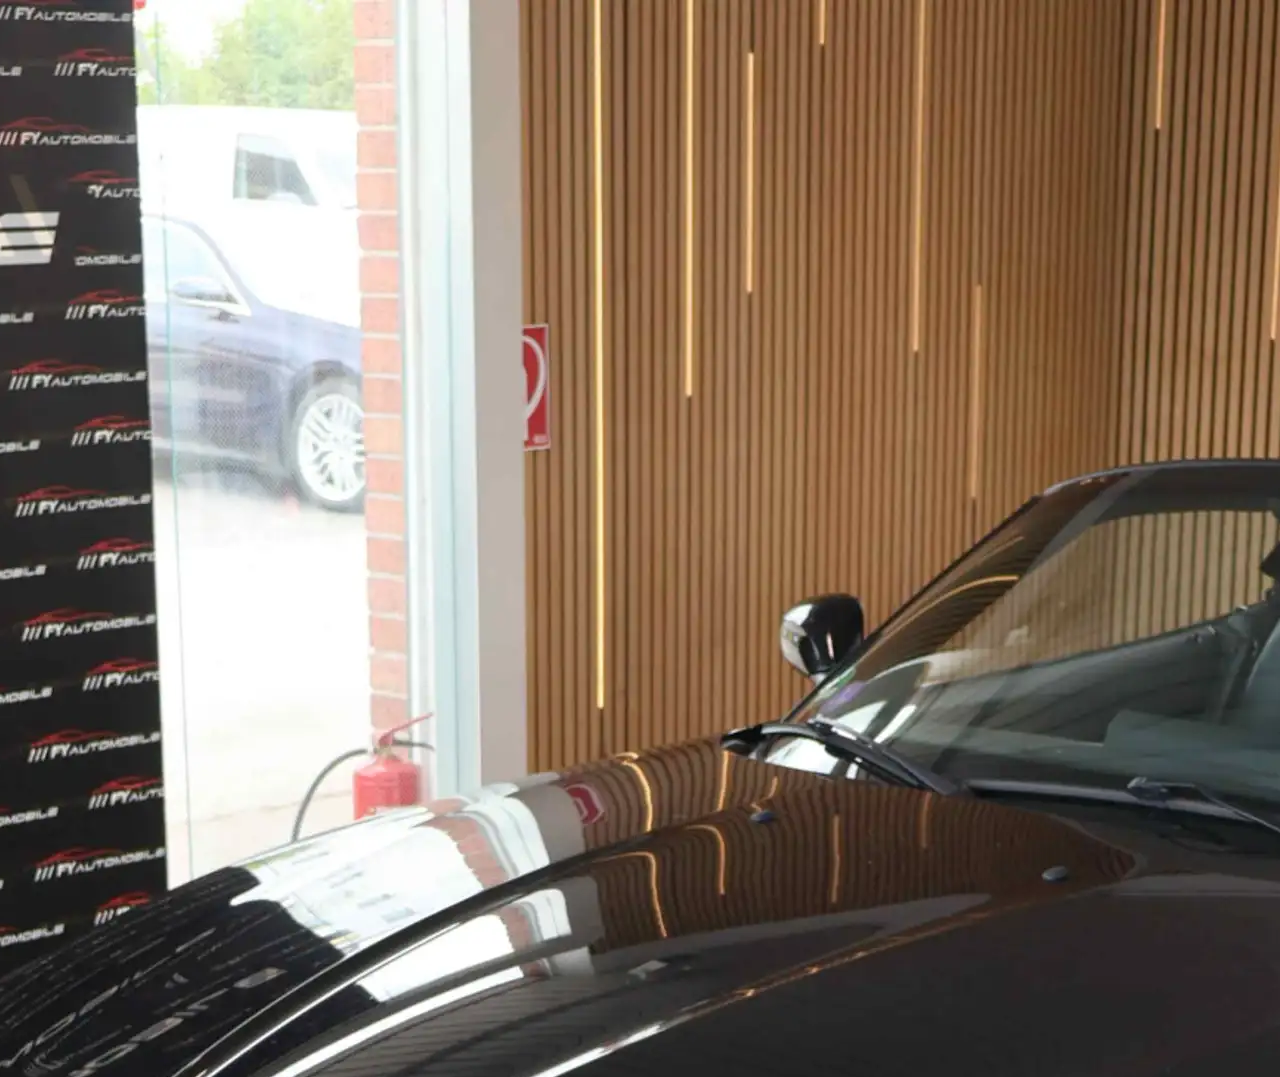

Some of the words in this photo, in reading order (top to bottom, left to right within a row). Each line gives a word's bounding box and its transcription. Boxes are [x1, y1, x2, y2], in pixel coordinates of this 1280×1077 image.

[31, 370, 148, 389] FYAUTOMOBILE
[37, 493, 153, 515] FYAUTOMOBILE
[43, 613, 157, 638] FYAUTOMOBILE
[50, 731, 161, 759] FYAUTOMOBILE
[56, 847, 165, 877] FYAUTOMOBILE
